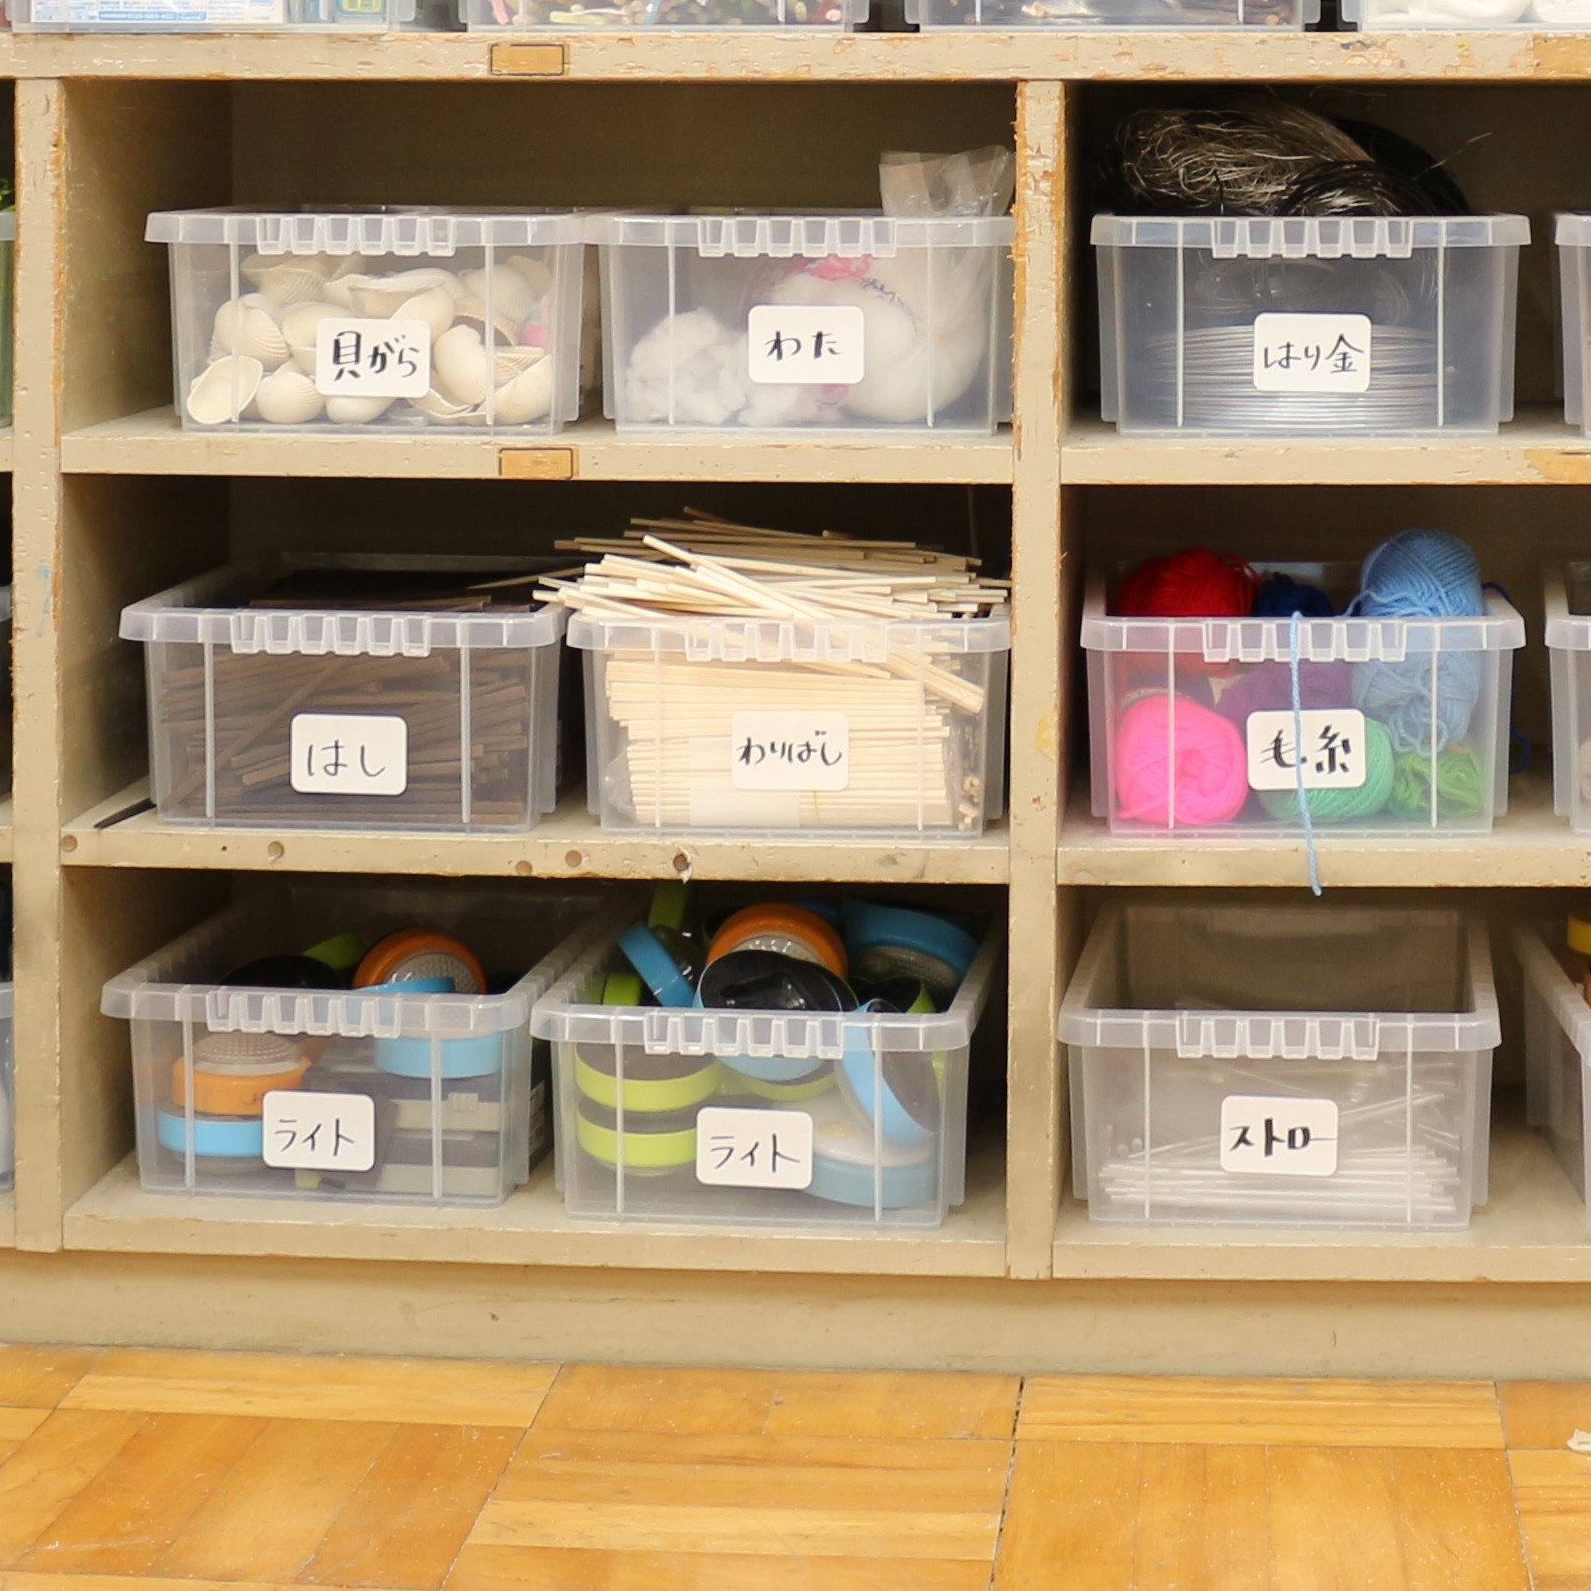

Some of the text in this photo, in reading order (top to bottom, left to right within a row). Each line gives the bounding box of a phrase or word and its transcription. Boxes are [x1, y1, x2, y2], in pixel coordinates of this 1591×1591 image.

[332, 329, 421, 382] 貝がら
[766, 329, 842, 362] わた
[1263, 333, 1366, 374] はり金
[306, 738, 386, 779] はし
[737, 729, 844, 768] わりばし
[274, 1117, 356, 1159] ライト
[709, 1132, 802, 1175] ライト
[1228, 1116, 1338, 1158] ストロー
